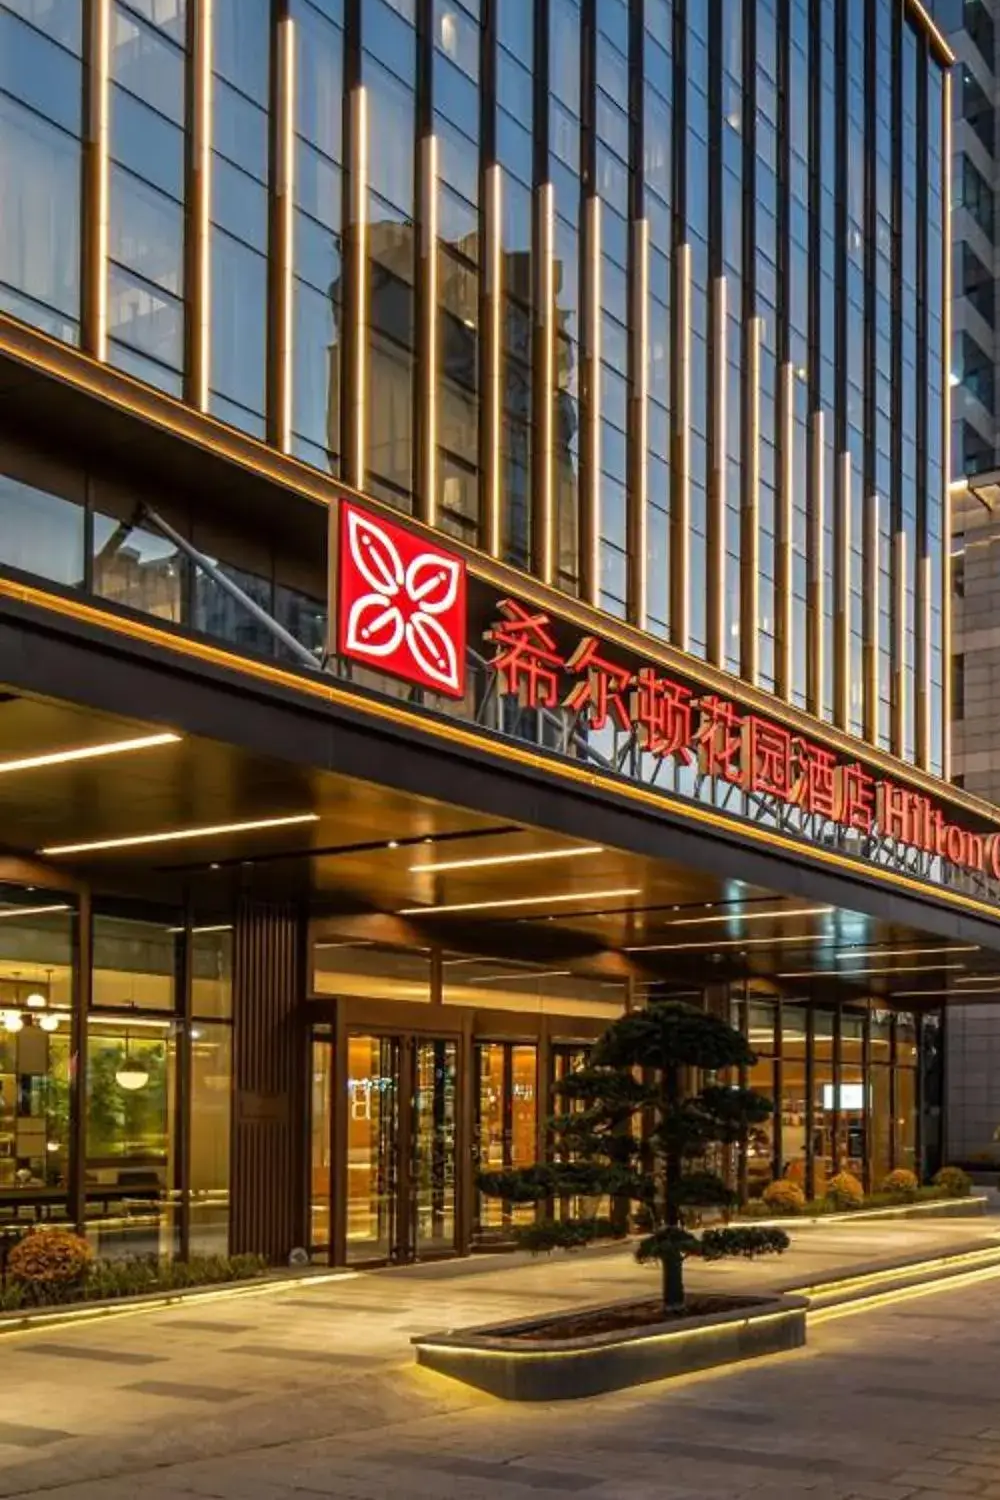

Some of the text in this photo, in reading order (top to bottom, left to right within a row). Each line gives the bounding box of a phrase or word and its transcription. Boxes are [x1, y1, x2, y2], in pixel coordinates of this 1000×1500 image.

[484, 599, 874, 835] 希尔顿花园酒店
[878, 780, 984, 871] Hilton
